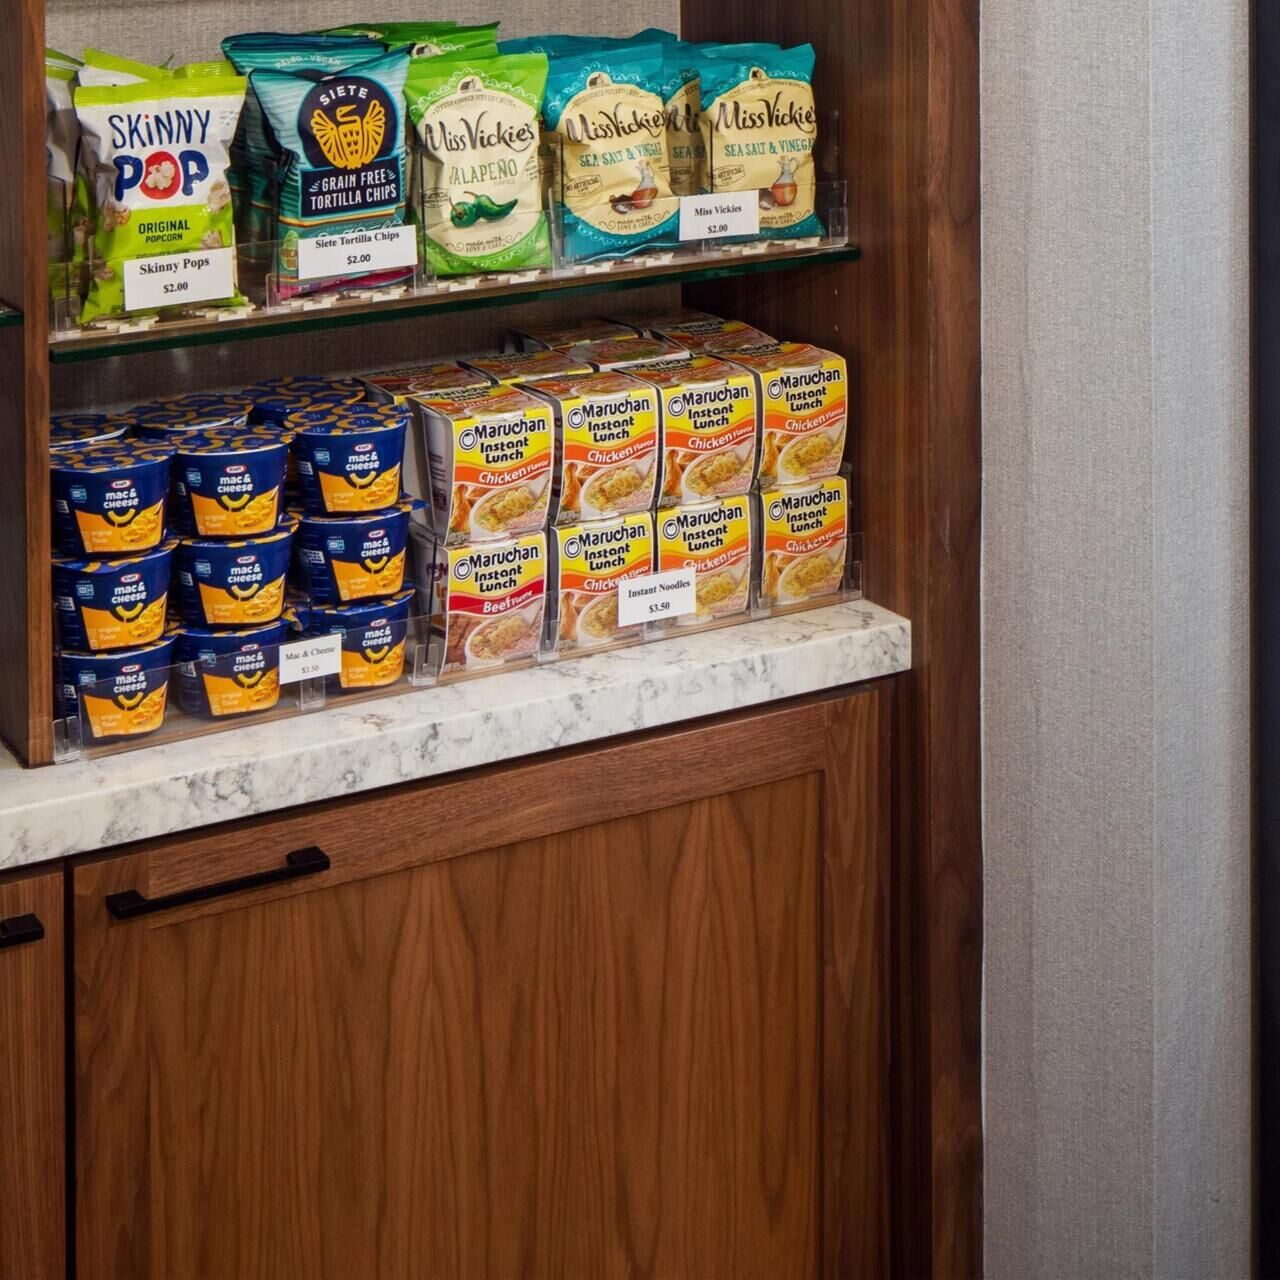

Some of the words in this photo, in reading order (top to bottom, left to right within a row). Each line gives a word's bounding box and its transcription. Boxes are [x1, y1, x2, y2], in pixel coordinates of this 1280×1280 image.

[319, 85, 369, 106] SIETE
[724, 144, 743, 157] SEA
[745, 142, 765, 156] SALT
[770, 141, 778, 154] &
[114, 150, 210, 201] POP
[322, 176, 357, 191] GRAIN
[361, 170, 386, 187] FREE
[449, 158, 517, 185] JALAPEÑO
[310, 189, 362, 210] TORTILLA
[365, 183, 396, 201] CHIPS
[695, 206, 712, 215] Miss
[715, 204, 742, 214] Vickies
[315, 238, 336, 248] Siete
[338, 235, 371, 246] Tortilla
[374, 230, 400, 242] Chips
[139, 261, 179, 277] Skinny
[182, 257, 210, 271] Pops
[475, 417, 546, 440] Maruchan
[480, 437, 529, 453] Instant
[485, 449, 523, 464] Lunch
[479, 466, 526, 485] Chicken
[528, 459, 549, 475] Flavor
[470, 544, 538, 570] Maruchan
[628, 586, 656, 598] Instant
[659, 580, 690, 593] Noodles
[483, 597, 510, 614] Beef
[511, 589, 532, 605] Flavor
[649, 601, 670, 613] $3.50
[285, 652, 302, 662] Mac
[304, 651, 309, 659] &
[311, 646, 335, 658] Cheese
